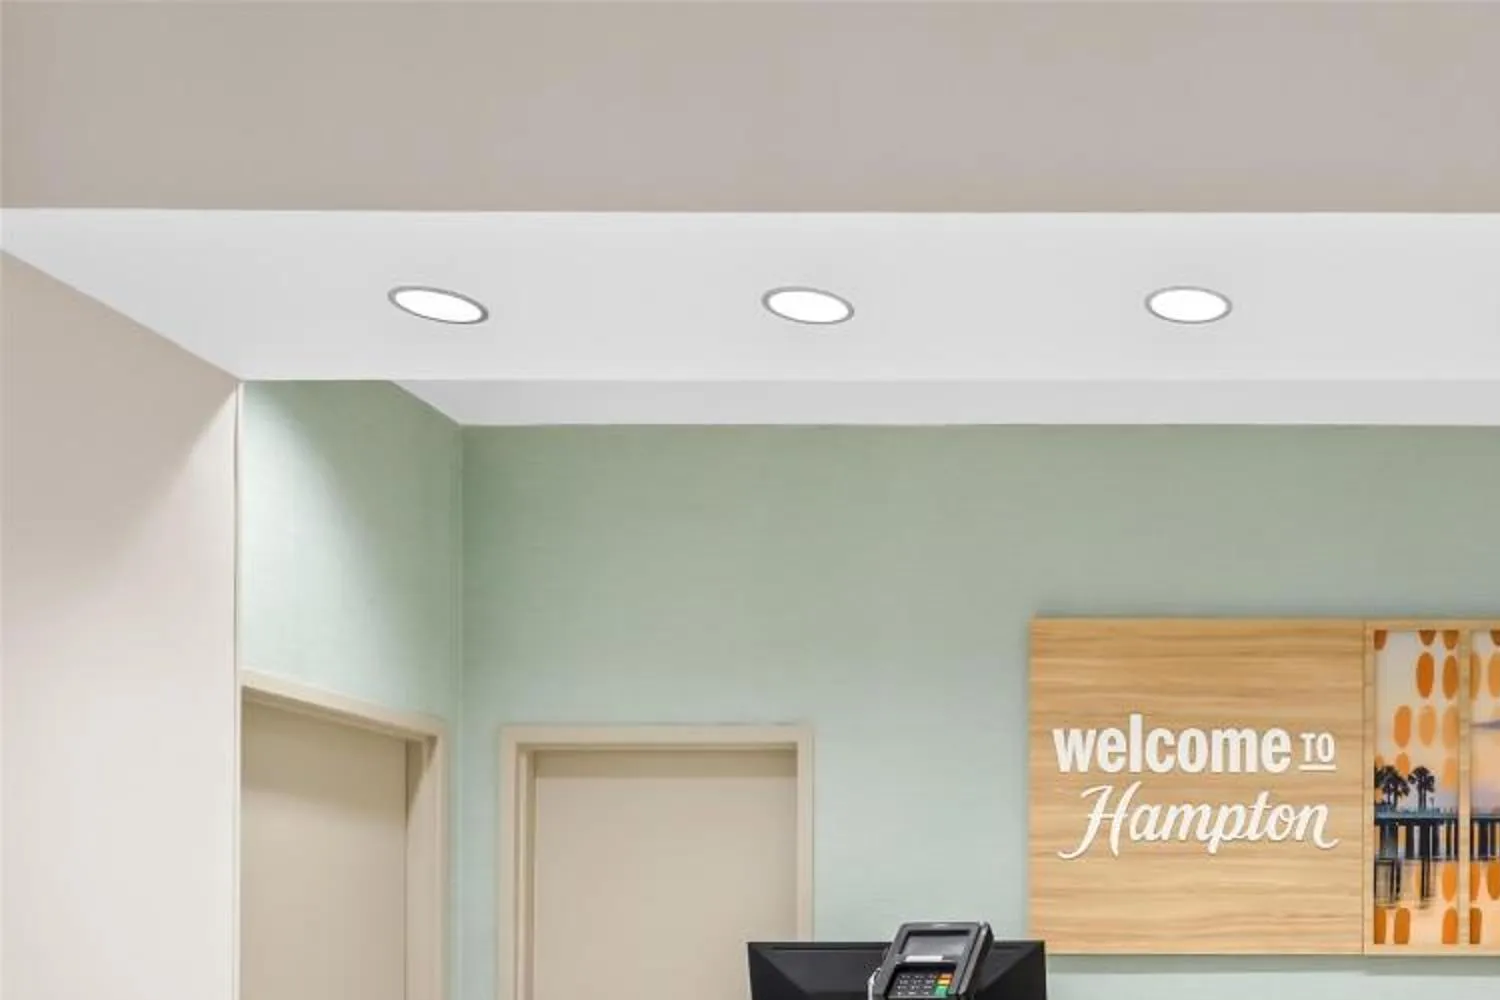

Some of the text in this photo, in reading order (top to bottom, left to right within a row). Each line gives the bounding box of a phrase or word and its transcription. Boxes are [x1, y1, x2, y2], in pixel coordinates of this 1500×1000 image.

[1052, 713, 1337, 773] welcome TO
[1057, 781, 1340, 860] Hampton
